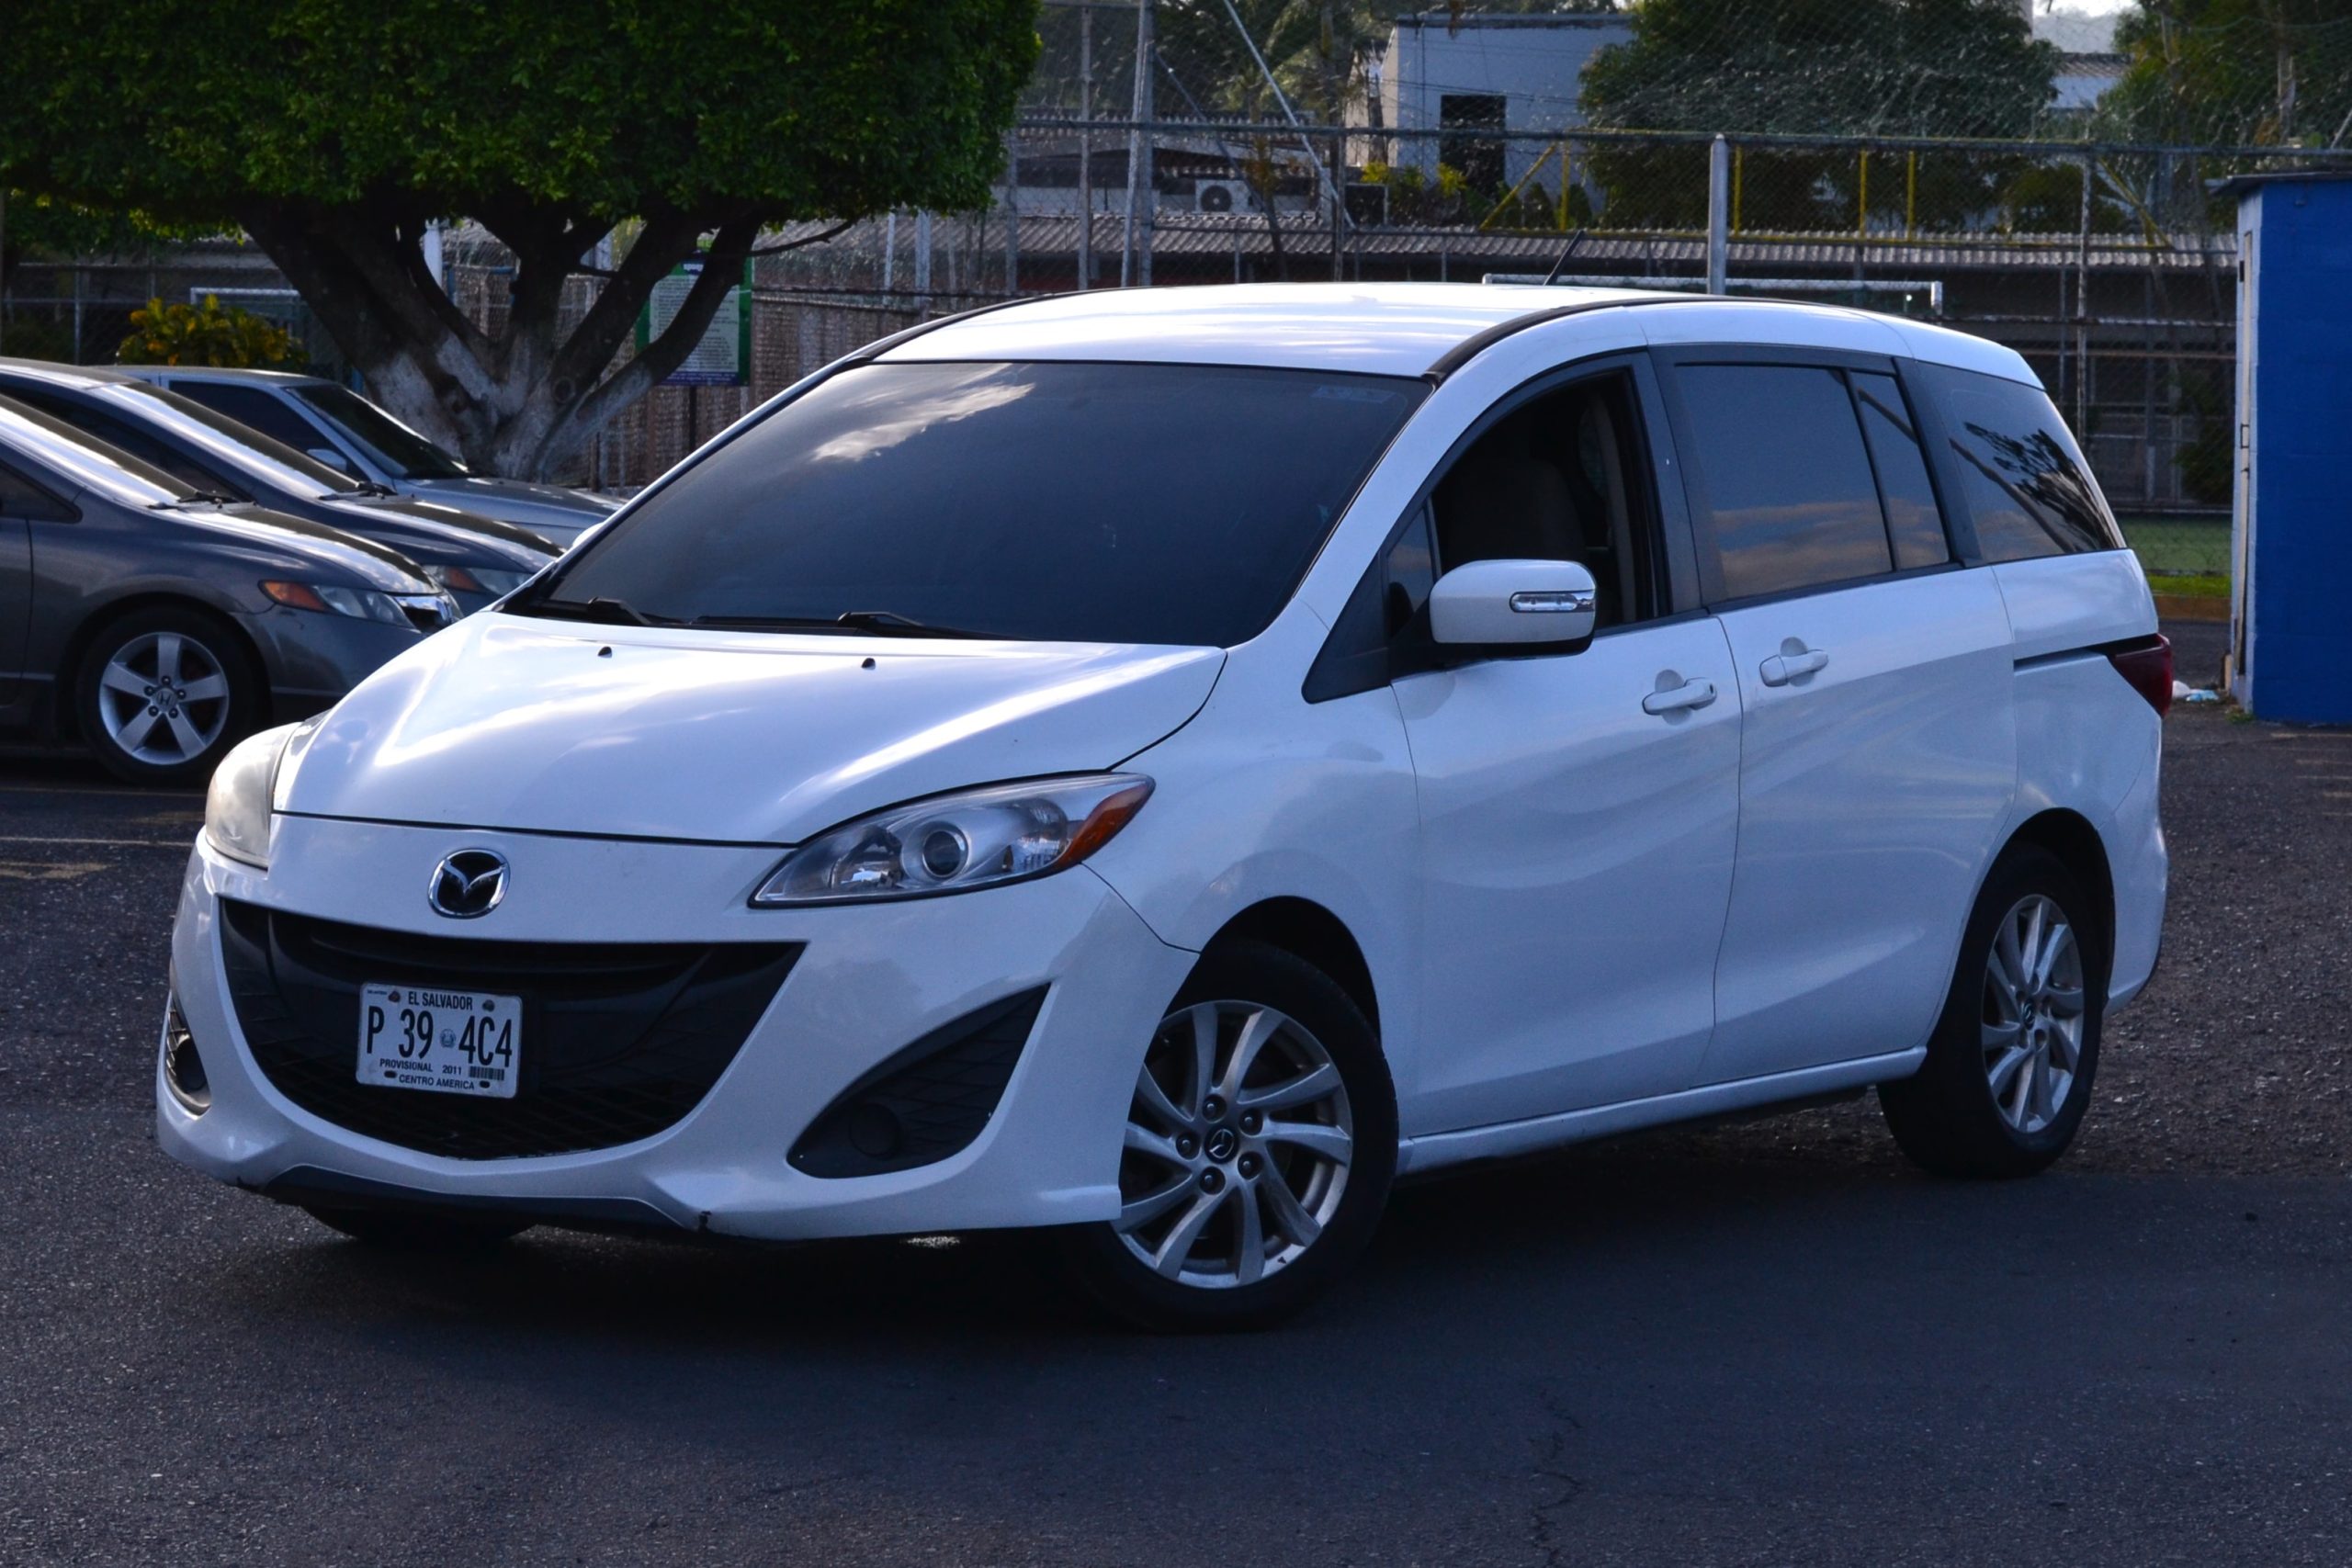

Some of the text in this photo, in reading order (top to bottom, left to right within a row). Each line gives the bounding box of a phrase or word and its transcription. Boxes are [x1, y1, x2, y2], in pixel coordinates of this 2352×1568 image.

[408, 991, 473, 1010] EL SALVADOR
[367, 1005, 513, 1067] P 39 4C4
[379, 1057, 462, 1075] PROVISIONAL 2011
[399, 1074, 475, 1090] CENTRO AMERICA
